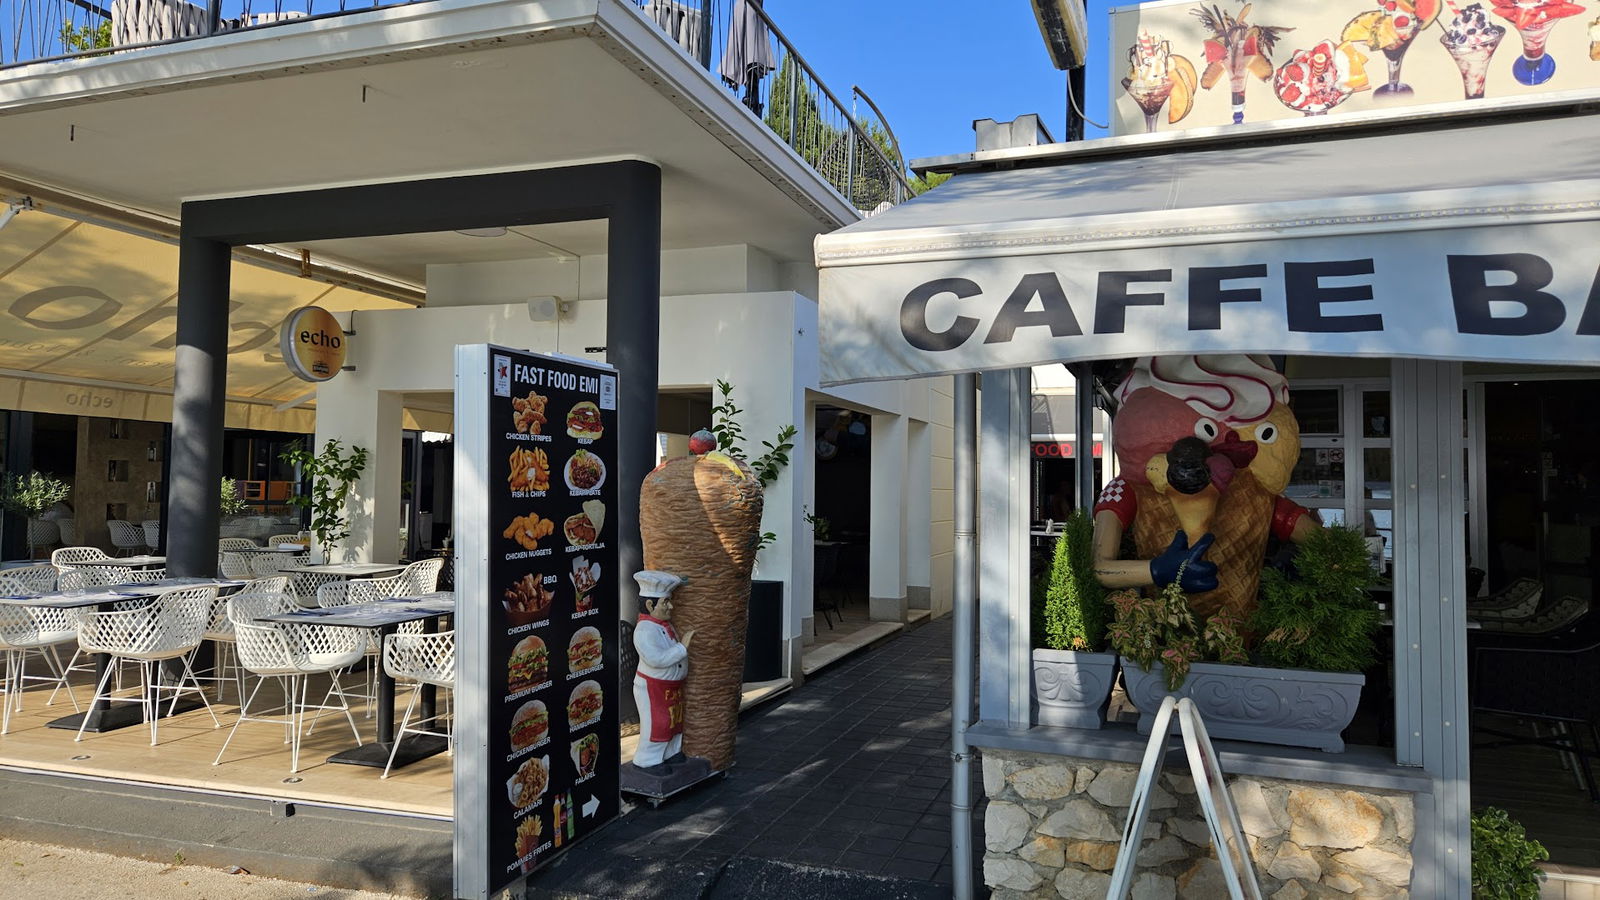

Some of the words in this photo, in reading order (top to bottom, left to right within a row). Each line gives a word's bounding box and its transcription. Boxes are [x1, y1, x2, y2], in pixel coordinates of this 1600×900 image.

[900, 258, 1384, 351] CAFFE
[1447, 252, 1600, 337] B
[301, 330, 340, 348] echo
[514, 363, 545, 386] FAST
[547, 369, 577, 391] FOOD
[579, 375, 599, 394] EMI
[505, 432, 530, 441] CHICKEN
[530, 433, 552, 443] STRIPES
[577, 437, 594, 445] KEBAP
[1030, 443, 1073, 457] OOD
[505, 551, 528, 561] CHICKEN
[528, 548, 552, 558] NUGGETS
[543, 575, 557, 585] BBQ
[571, 611, 588, 620] KEBAP
[587, 608, 599, 616] BOX
[508, 623, 531, 636] CHICKEN
[531, 619, 550, 630] WINGS
[566, 663, 604, 681] CHEESEBURGER
[569, 715, 601, 733] HAMBURGER
[506, 736, 551, 762] CHICKENBURGER
[575, 770, 596, 786] FALAFEL
[513, 798, 543, 819] CALAMARI
[533, 840, 552, 857] FRITES
